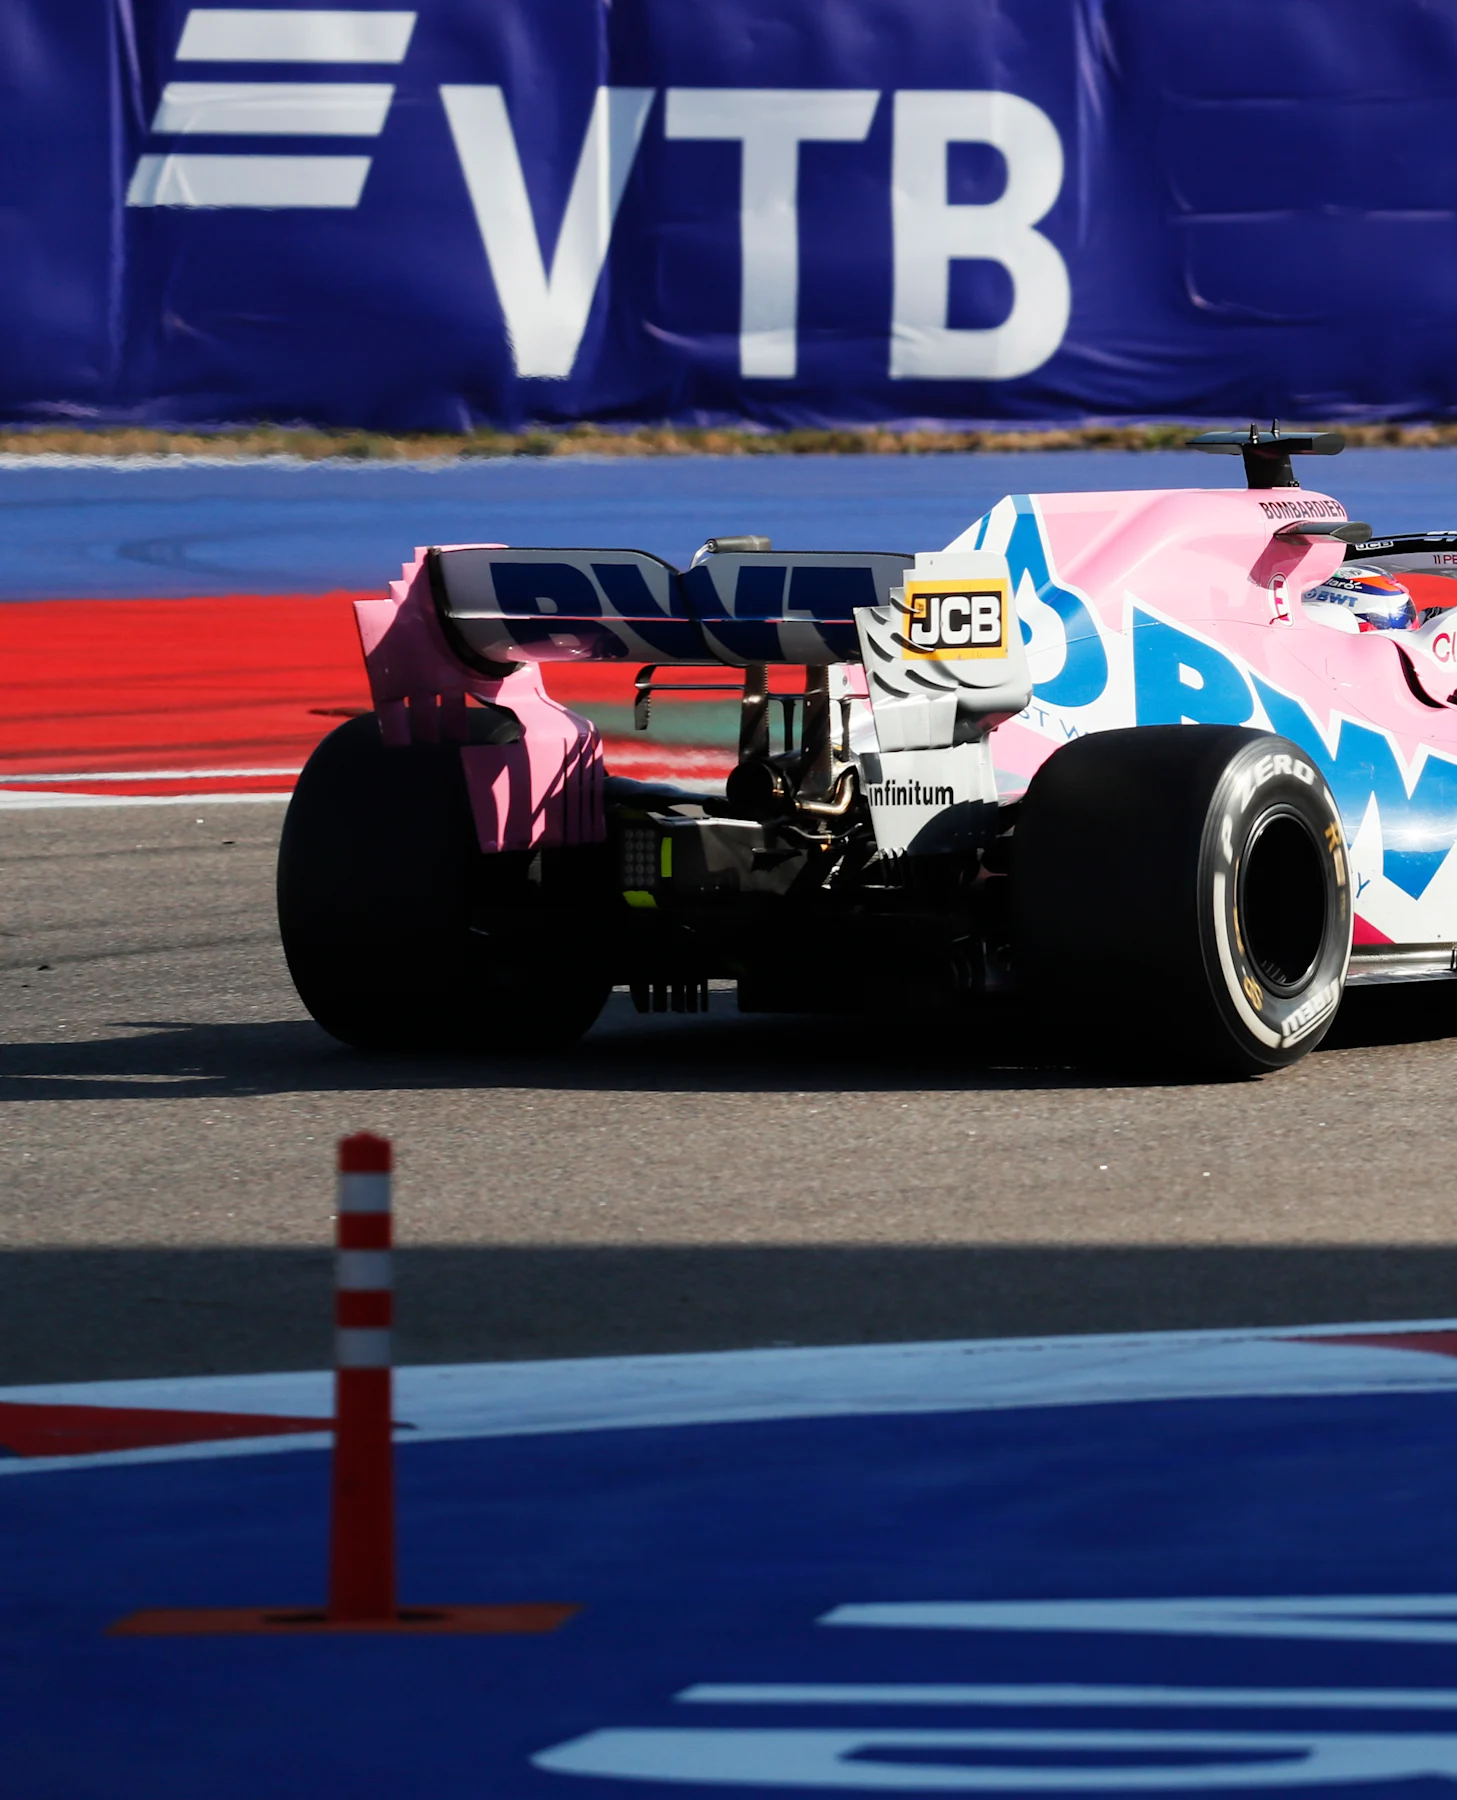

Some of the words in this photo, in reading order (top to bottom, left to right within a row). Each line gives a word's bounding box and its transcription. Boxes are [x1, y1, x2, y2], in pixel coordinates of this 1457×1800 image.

[439, 85, 1071, 380] VTB
[1258, 500, 1346, 519] BOMBARDIER
[1433, 554, 1442, 565] 11
[1325, 578, 1359, 590] laro
[1316, 590, 1358, 608] BWT
[911, 596, 1001, 645] JCB
[868, 779, 955, 806] infinitum
[1231, 754, 1317, 814] ZERO
